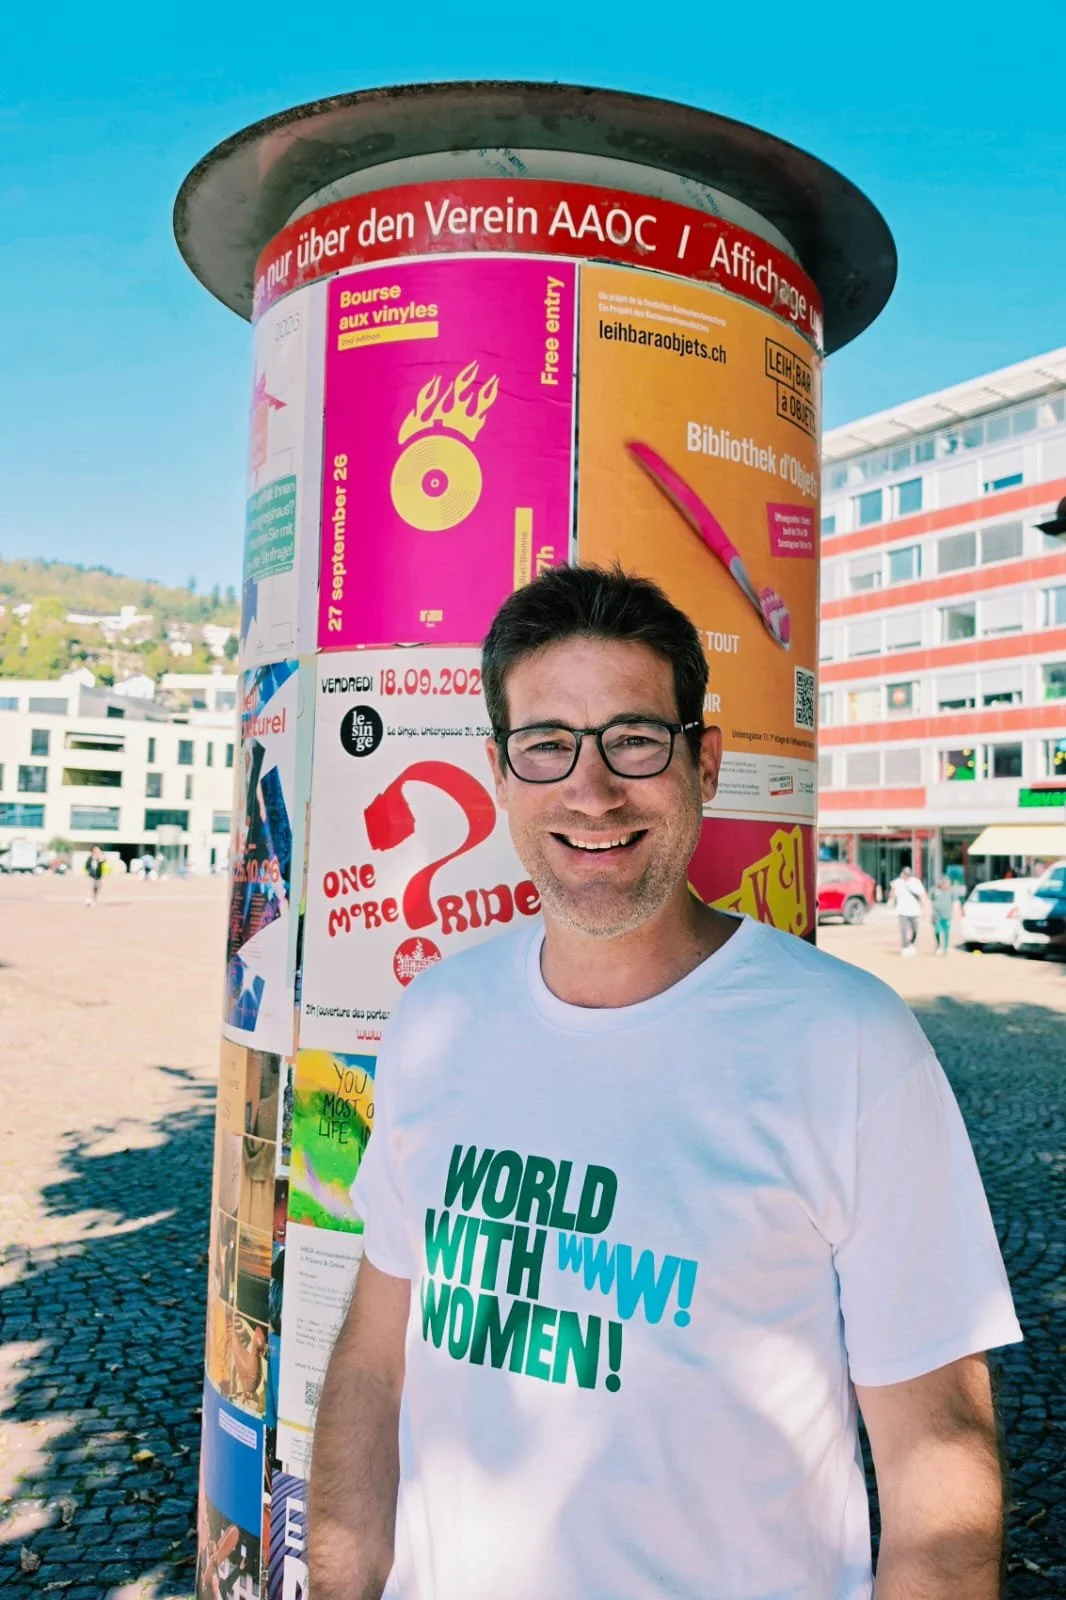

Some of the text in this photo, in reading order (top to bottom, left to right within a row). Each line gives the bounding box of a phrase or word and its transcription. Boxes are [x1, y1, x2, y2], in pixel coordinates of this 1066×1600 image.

[266, 250, 292, 290] nur
[297, 224, 350, 269] über
[358, 208, 415, 247] den
[425, 197, 538, 236] Verein
[548, 201, 657, 251] AAOC
[710, 237, 807, 320] Affichage
[338, 301, 438, 330] aux vinyles
[340, 284, 401, 308] Bourse
[541, 275, 565, 385] Free entry
[599, 320, 727, 364] leihbaraobjets.ch
[769, 348, 812, 395] LEIH BAR
[687, 421, 776, 476] Bibliothek
[328, 453, 348, 632] 27 september 26
[536, 545, 555, 577] 7h
[705, 631, 740, 654] TOUT
[321, 668, 483, 696] VENDREDI 18.09.202
[352, 711, 365, 725] le
[333, 1062, 368, 1098] YOU
[323, 1094, 359, 1119] MOST
[319, 1120, 348, 1145] LIFE
[444, 1144, 618, 1235] WORLD
[424, 1208, 548, 1301] WITH
[557, 1231, 698, 1328] WWW!
[421, 1275, 623, 1393] WOMEN!
